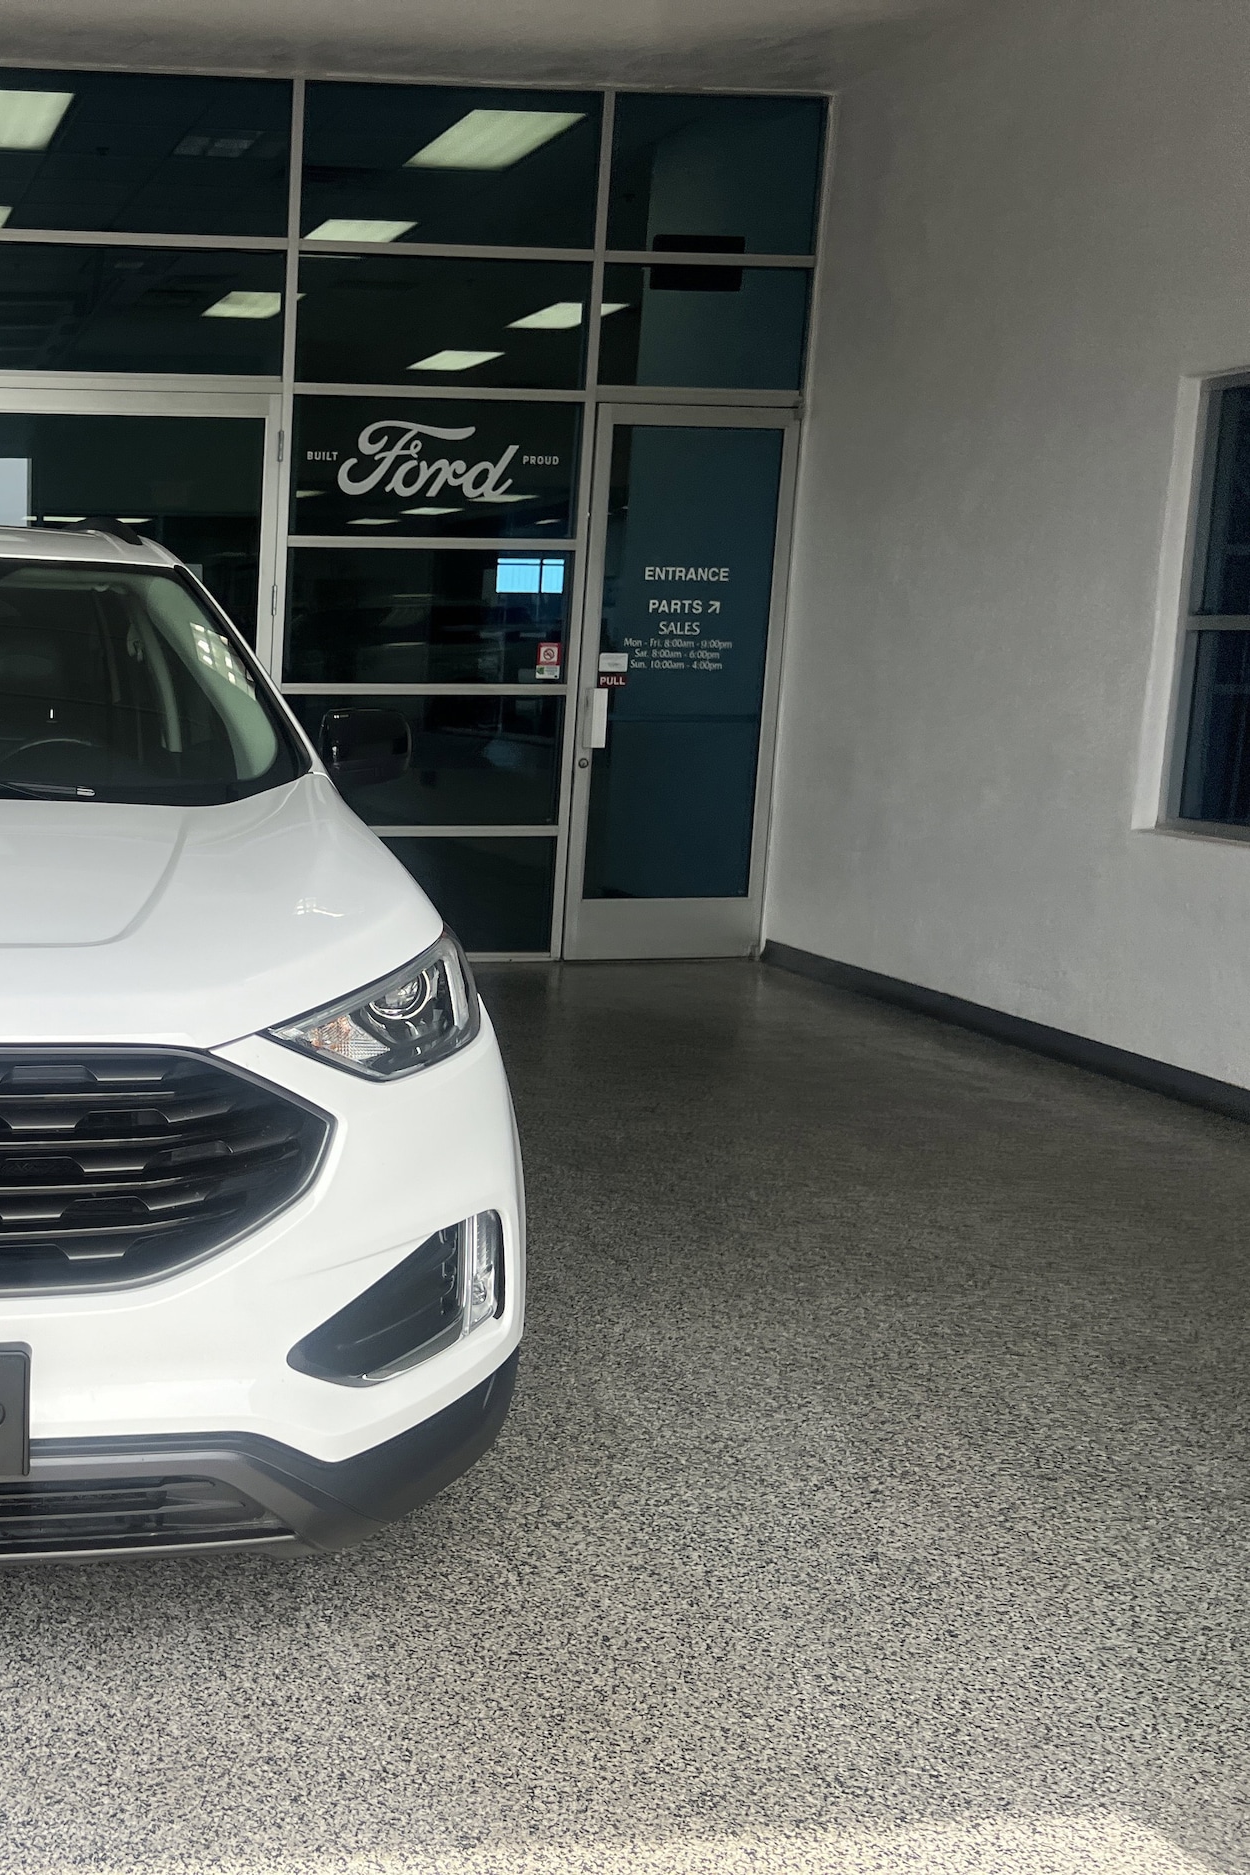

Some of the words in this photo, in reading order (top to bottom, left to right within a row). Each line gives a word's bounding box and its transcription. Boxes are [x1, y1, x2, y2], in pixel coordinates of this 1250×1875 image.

[307, 451, 338, 461] BUILT
[337, 420, 520, 498] Ford
[522, 455, 560, 466] PROUD
[644, 566, 730, 582] ENTRANCE
[648, 599, 703, 614] PARTS
[658, 621, 701, 635] SALES
[623, 637, 643, 647] Mon
[663, 638, 695, 648] 8:00am
[600, 676, 626, 686] PULL
